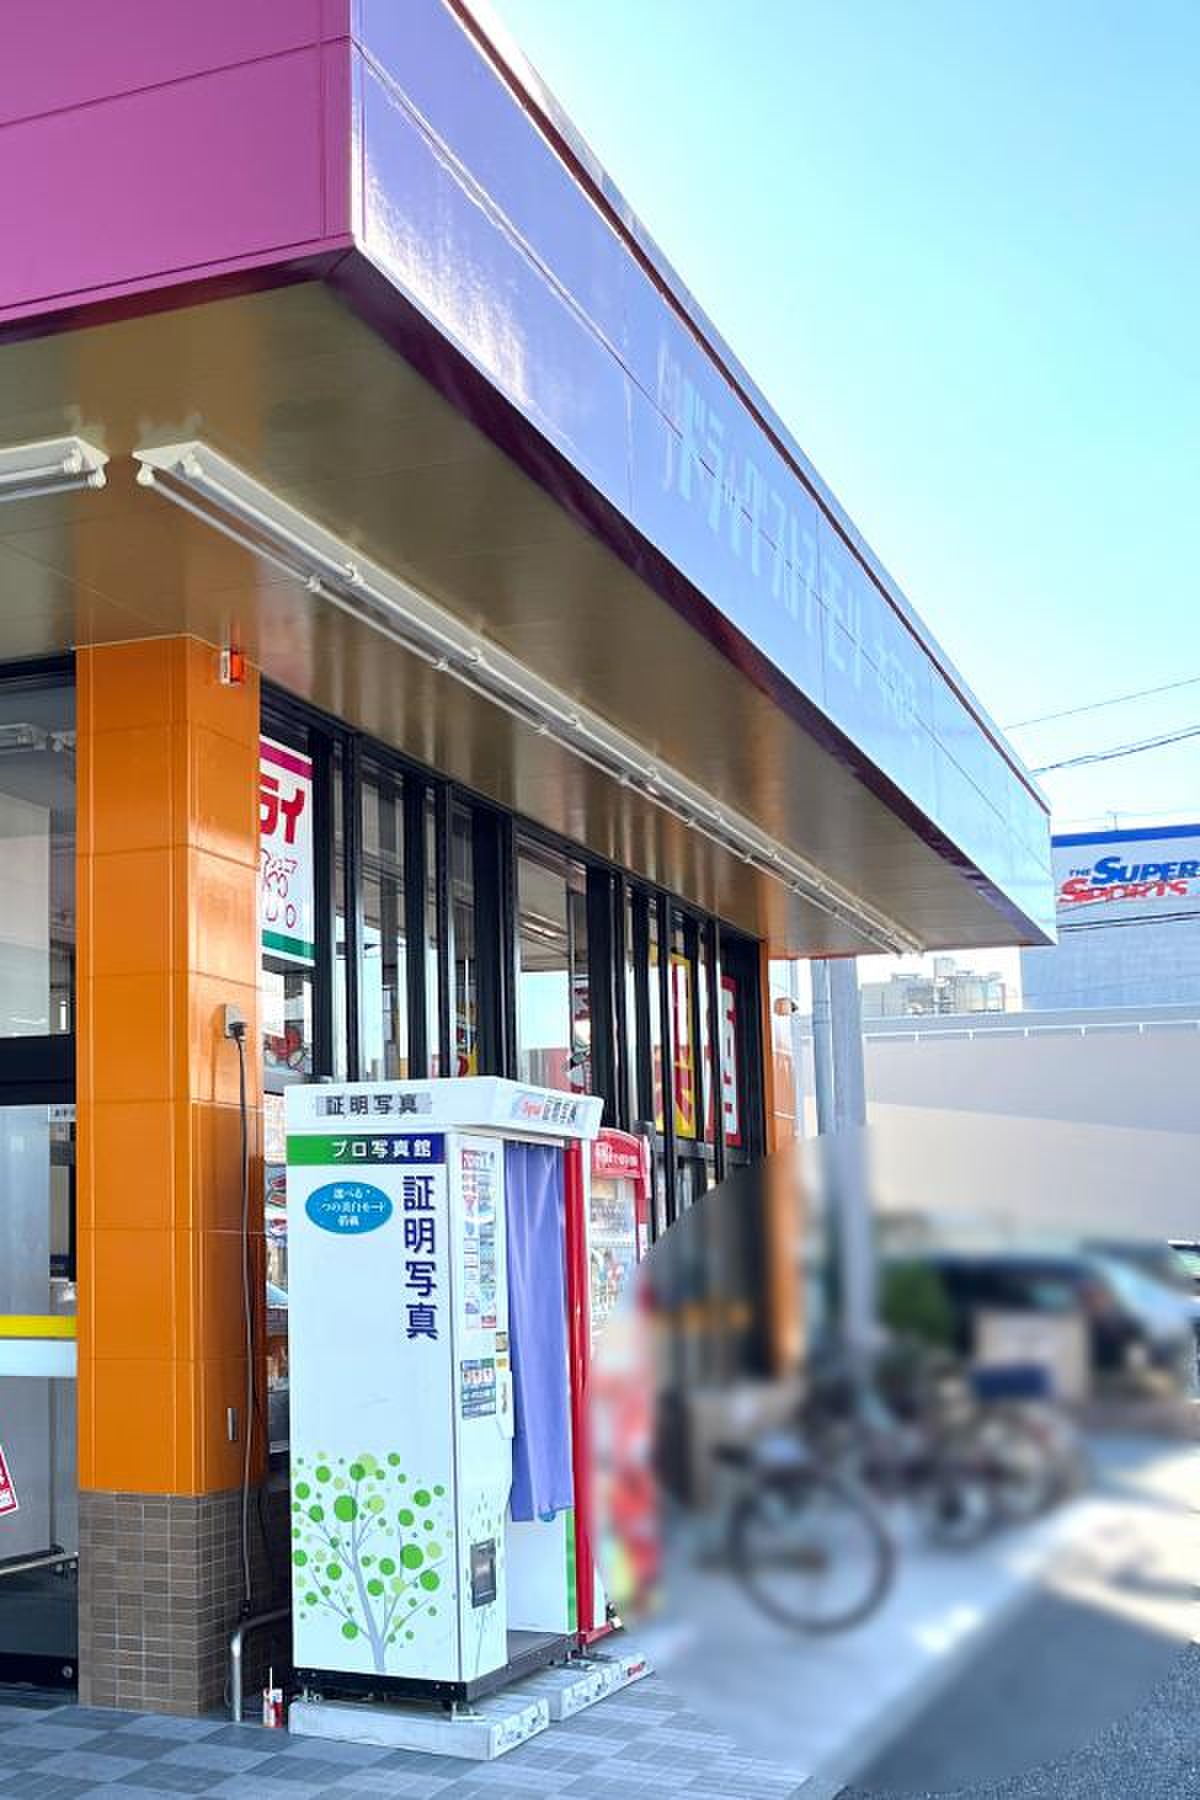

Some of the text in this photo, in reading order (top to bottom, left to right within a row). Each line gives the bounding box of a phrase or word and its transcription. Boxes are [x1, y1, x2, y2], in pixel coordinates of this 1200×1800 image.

[1091, 856, 1200, 885] SUPER
[326, 1093, 418, 1116] 証明写真
[332, 1138, 432, 1159] プロ写真館
[403, 1174, 438, 1340] 証明写真
